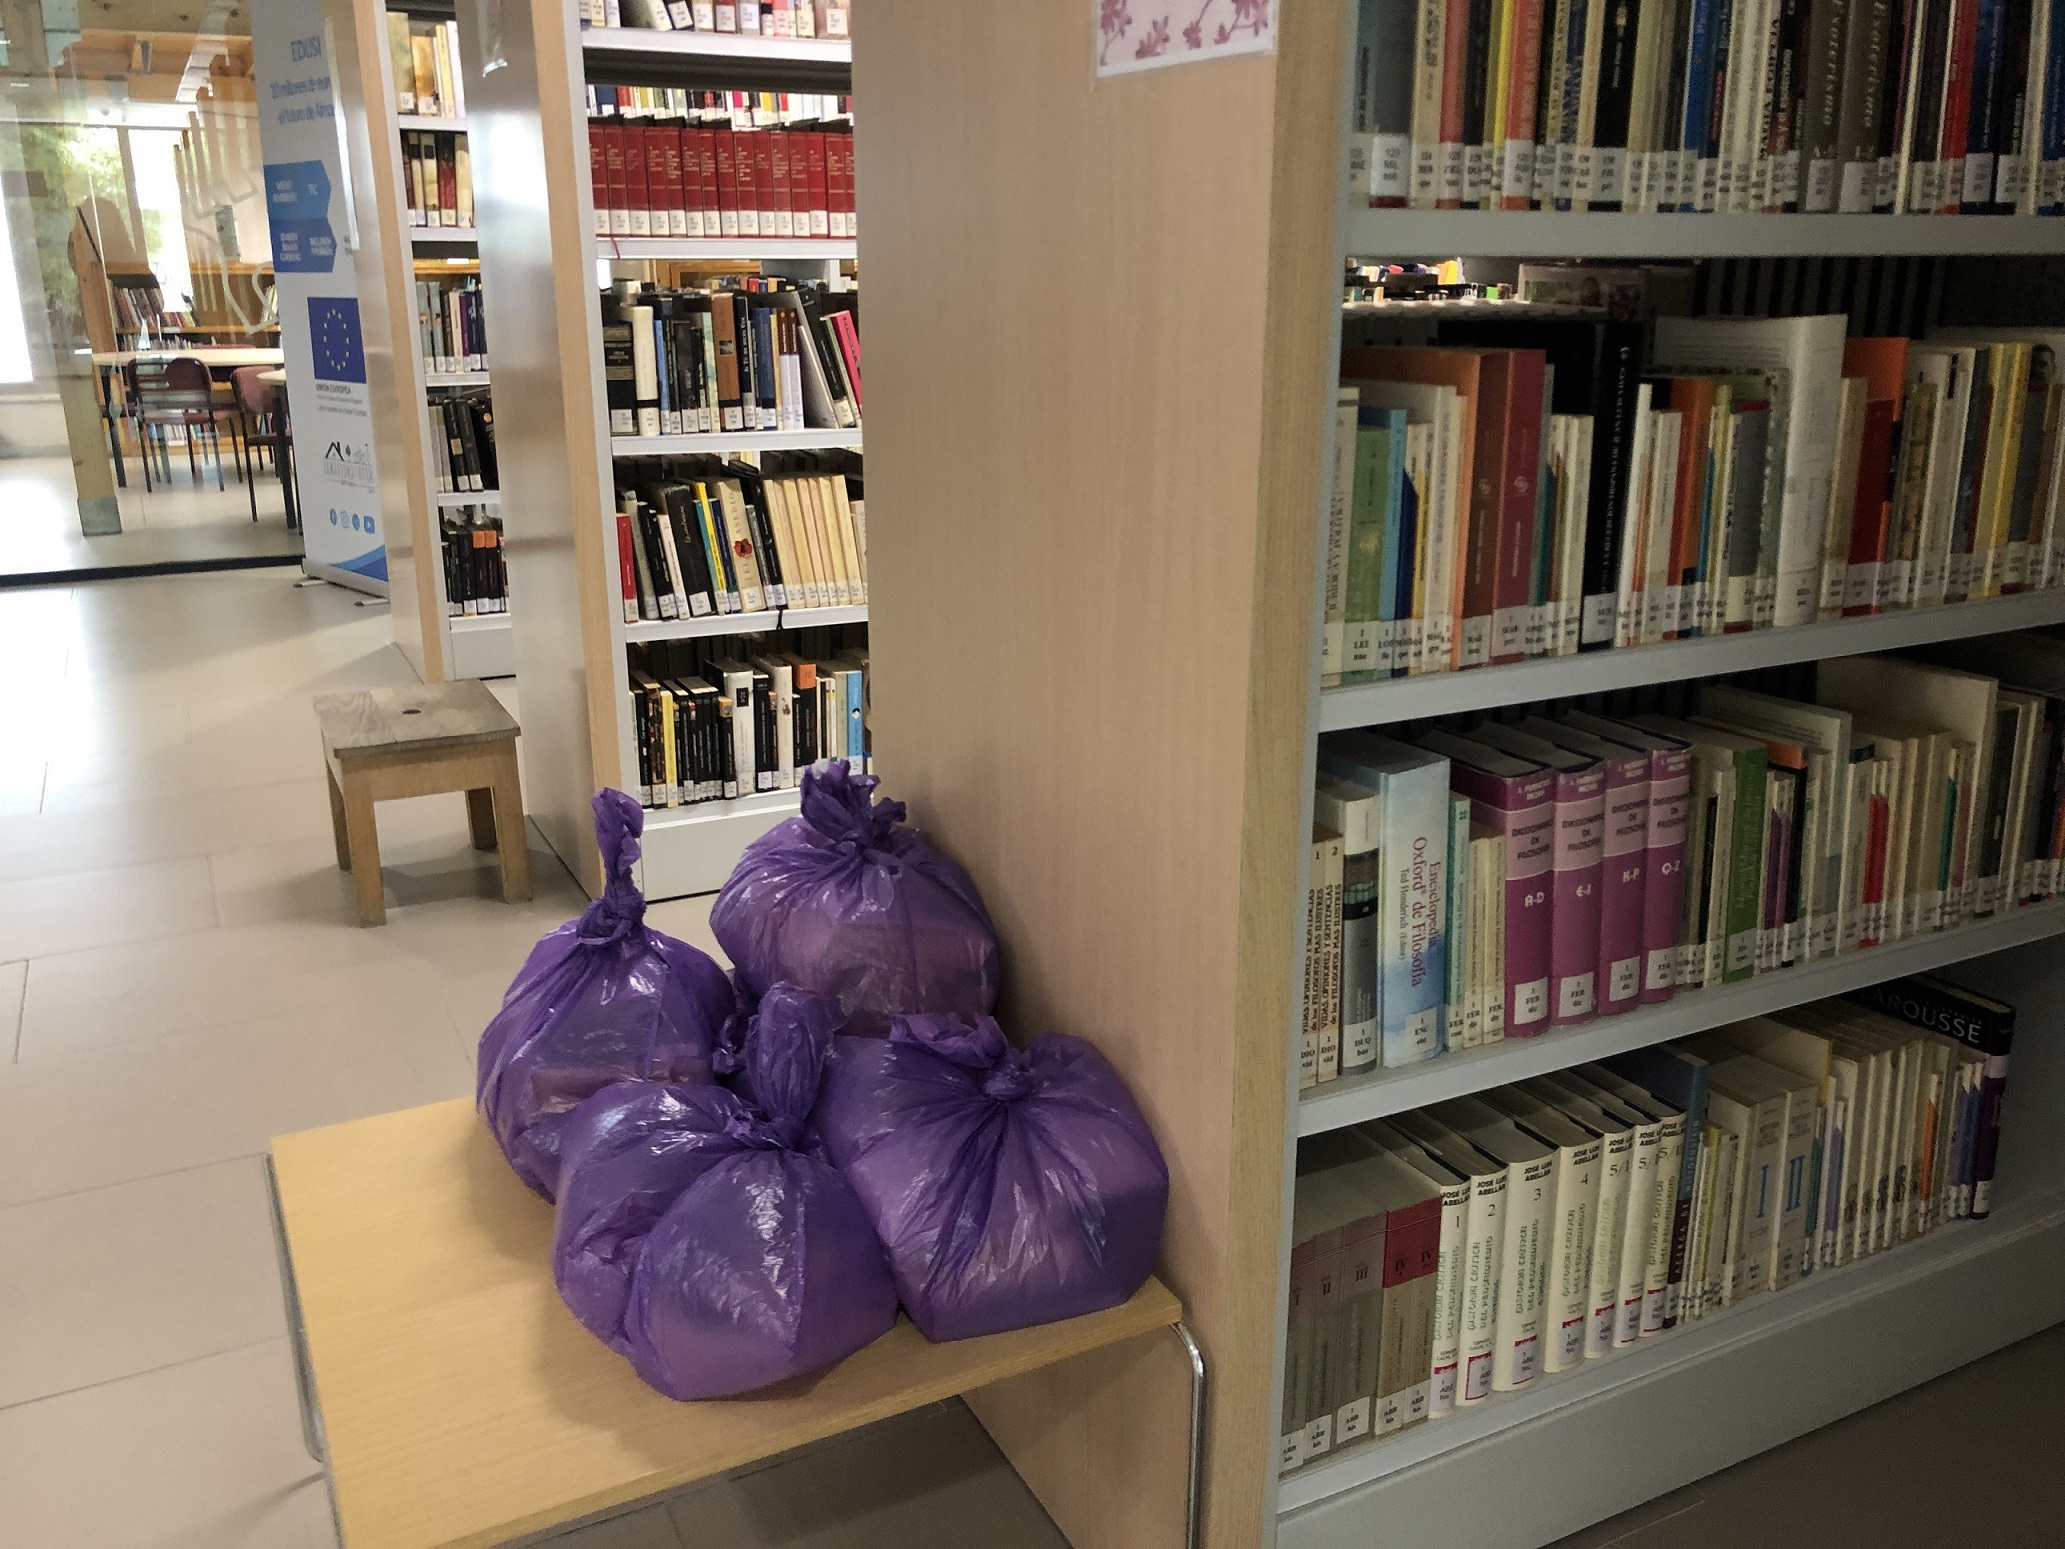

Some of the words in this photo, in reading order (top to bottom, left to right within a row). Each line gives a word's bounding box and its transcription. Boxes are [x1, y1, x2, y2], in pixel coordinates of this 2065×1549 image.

[1315, 850, 1320, 860] 1
[1331, 846, 1339, 856] 2
[1427, 862, 1441, 948] Enciclopedia
[1525, 891, 1545, 907] A-D
[1324, 884, 1333, 941] SENTENCIAS
[1413, 901, 1426, 919] de
[1581, 1173, 1589, 1185] 4
[1786, 1154, 1806, 1212] II
[1533, 1188, 1542, 1201] 3
[1488, 1204, 1496, 1217] 2
[1455, 1216, 1460, 1228] 1
[1355, 1266, 1368, 1282] III
